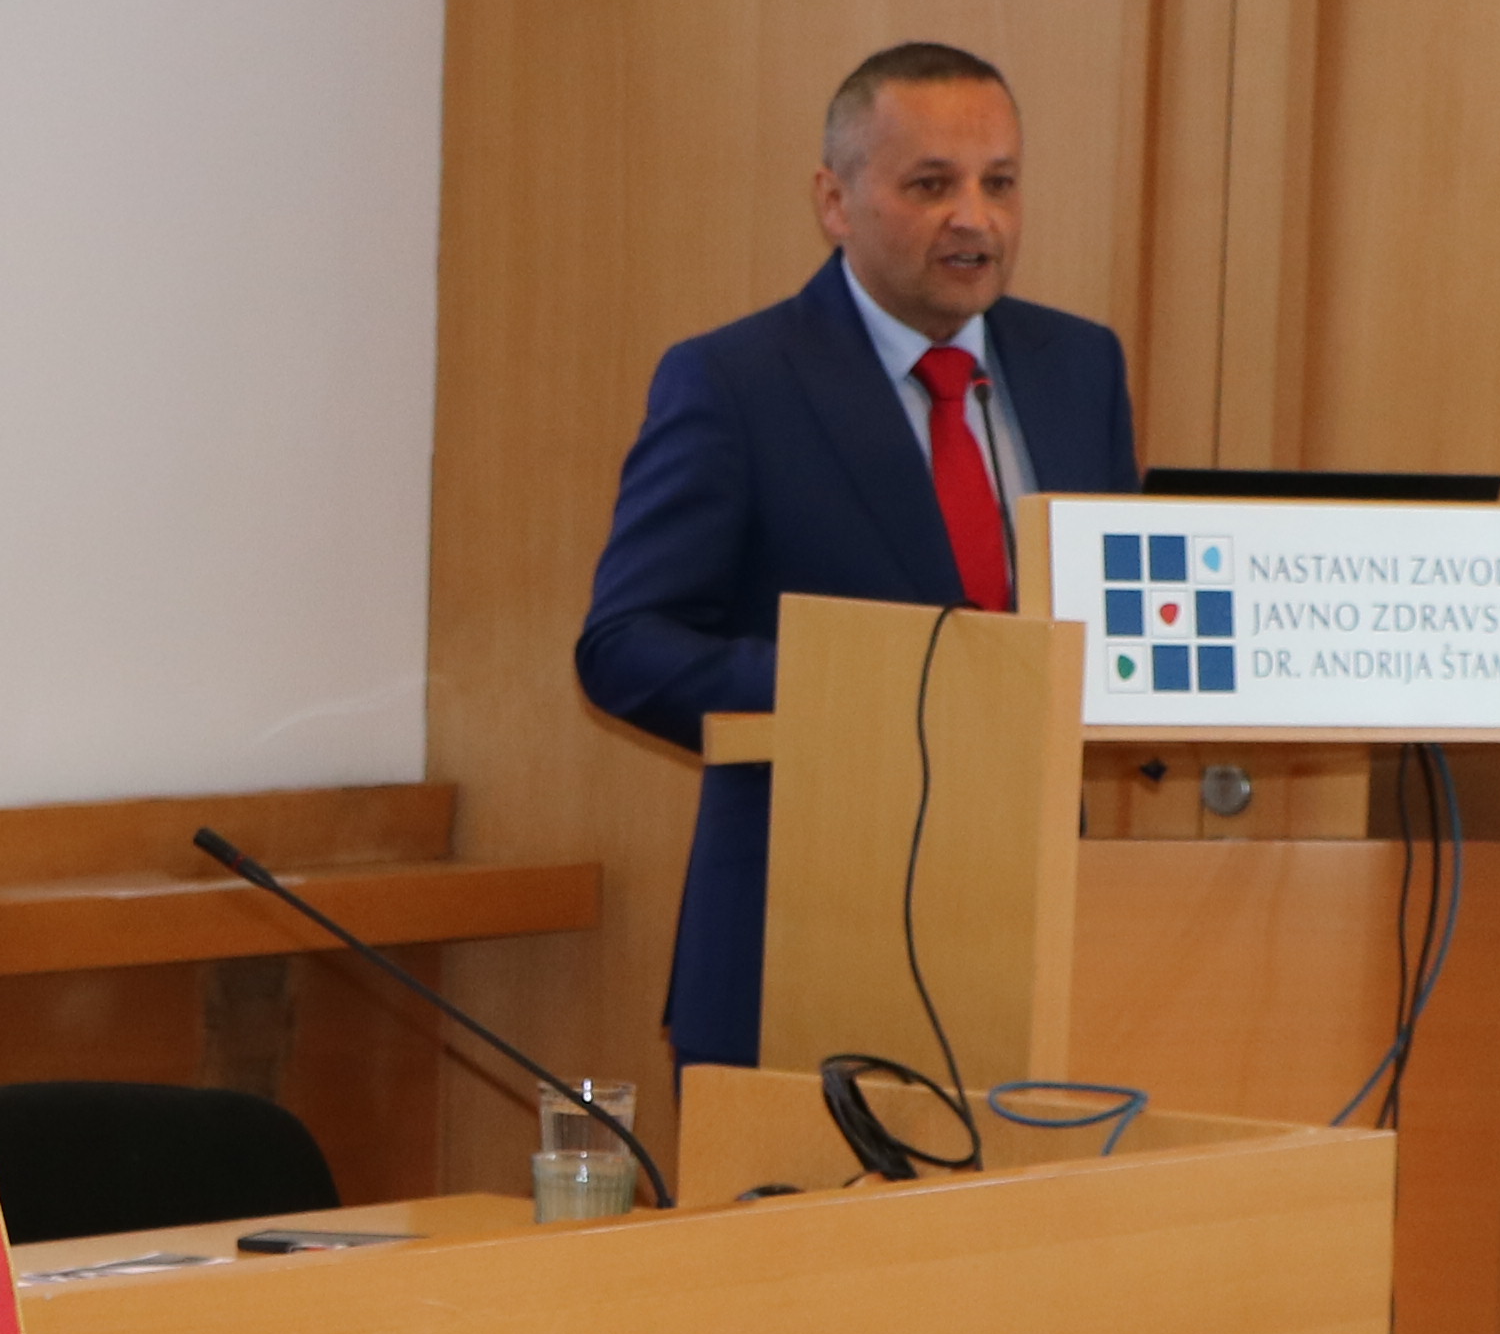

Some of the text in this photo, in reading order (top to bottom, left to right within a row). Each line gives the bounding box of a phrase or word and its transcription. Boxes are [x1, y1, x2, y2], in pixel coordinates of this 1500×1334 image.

[1249, 554, 1399, 586] NASTAVNI
[1251, 602, 1359, 636] JAVNO
[1252, 649, 1300, 679] DR.
[1311, 649, 1433, 682] ANDRIJA
